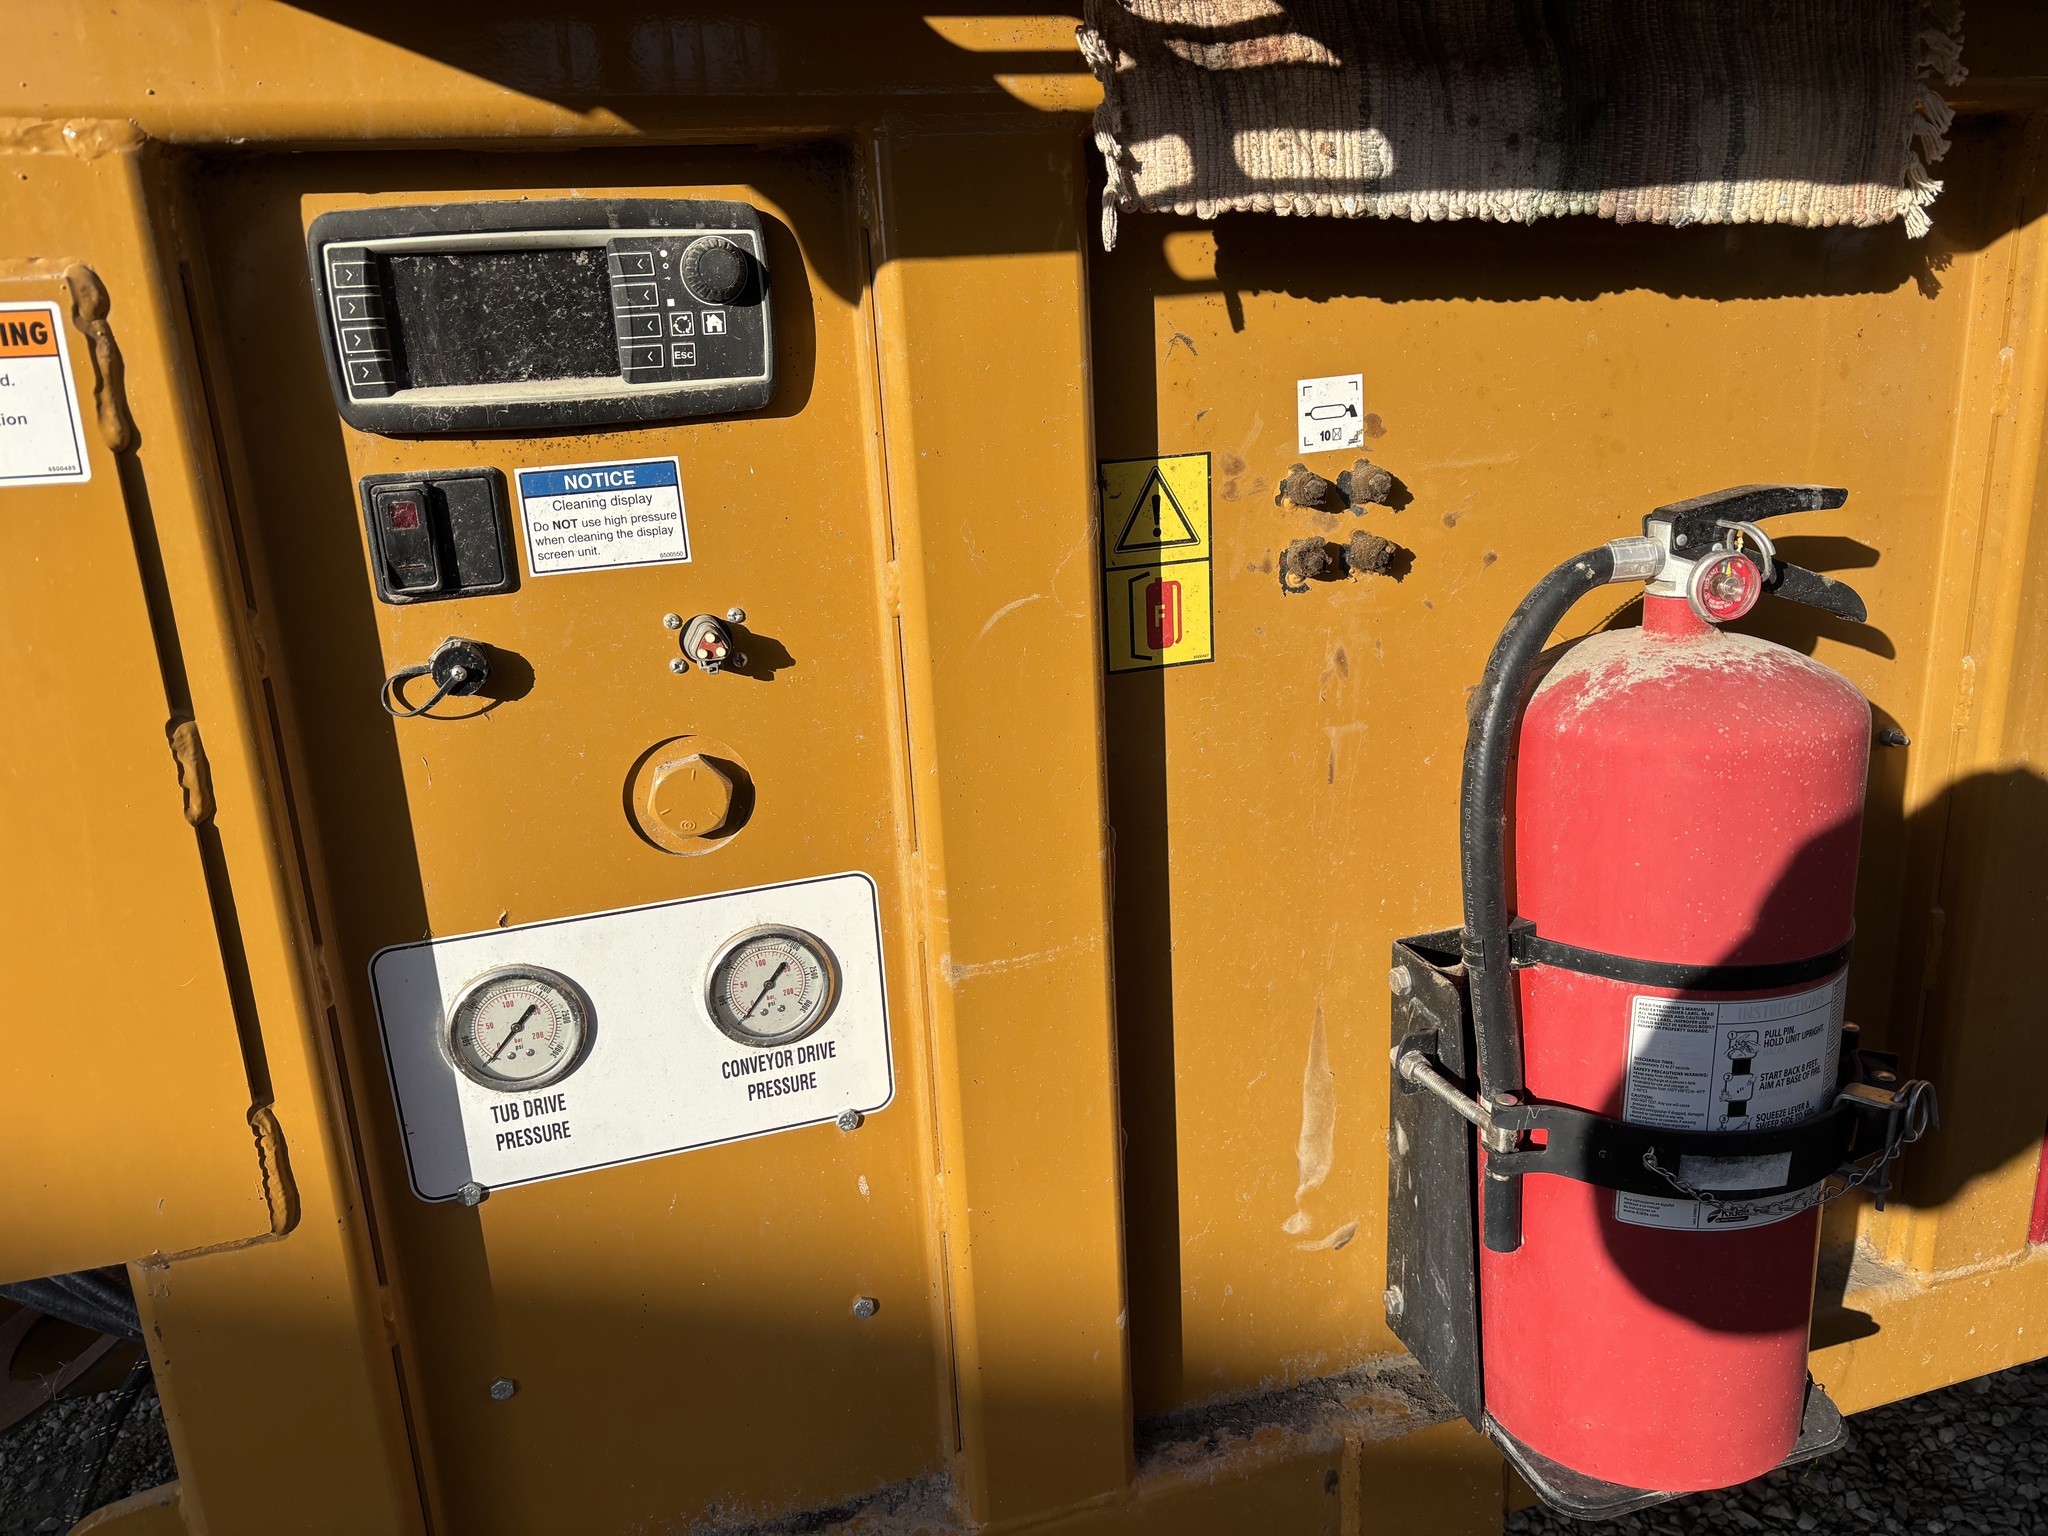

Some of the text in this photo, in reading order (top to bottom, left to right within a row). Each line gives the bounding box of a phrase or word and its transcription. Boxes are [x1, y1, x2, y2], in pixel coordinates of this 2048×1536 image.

[0, 321, 48, 346] ING
[0, 413, 27, 426] ion
[1320, 430, 1331, 442] 10
[563, 470, 637, 490] NOTICE
[552, 493, 653, 512] Cleaning display
[533, 511, 677, 532] Do NOT use high pressure
[535, 525, 674, 546] when cleaning the display
[538, 546, 601, 561] screen unit.
[1154, 605, 1165, 628] F
[1464, 808, 1472, 844] 167-08
[1523, 571, 1558, 610] BOOSTER
[755, 959, 767, 967] 100
[809, 965, 818, 980] 2500
[783, 988, 794, 997] 200
[502, 1000, 514, 1008] 100
[800, 1000, 812, 1013] 3000
[1737, 991, 1824, 1021] INSTRUCTIONS
[486, 1022, 494, 1030] 50
[561, 1009, 571, 1024] 2500
[532, 1031, 544, 1040] 200
[1763, 1024, 1824, 1048] HOLD UNIT UPRIGHT.
[1764, 1025, 1796, 1039] PULL PIN.
[515, 1043, 524, 1051] psi
[549, 1044, 564, 1058] 3000
[721, 1040, 837, 1080] CONVEYOR DRIVE
[1759, 1065, 1821, 1091] AIM AT BASE OF FIRE.
[1760, 1069, 1783, 1082] START
[1784, 1065, 1800, 1077] BACK
[1806, 1058, 1819, 1069] FEET.
[747, 1071, 818, 1102] PRESSURE
[490, 1093, 567, 1125] TUB DRIVE
[1756, 1100, 1810, 1122] SQUEEZE LEVER &
[1755, 1119, 1780, 1130] SWEEP
[1780, 1114, 1794, 1126] SIDE
[1795, 1112, 1803, 1121] TO
[495, 1120, 572, 1152] PRESSURE
